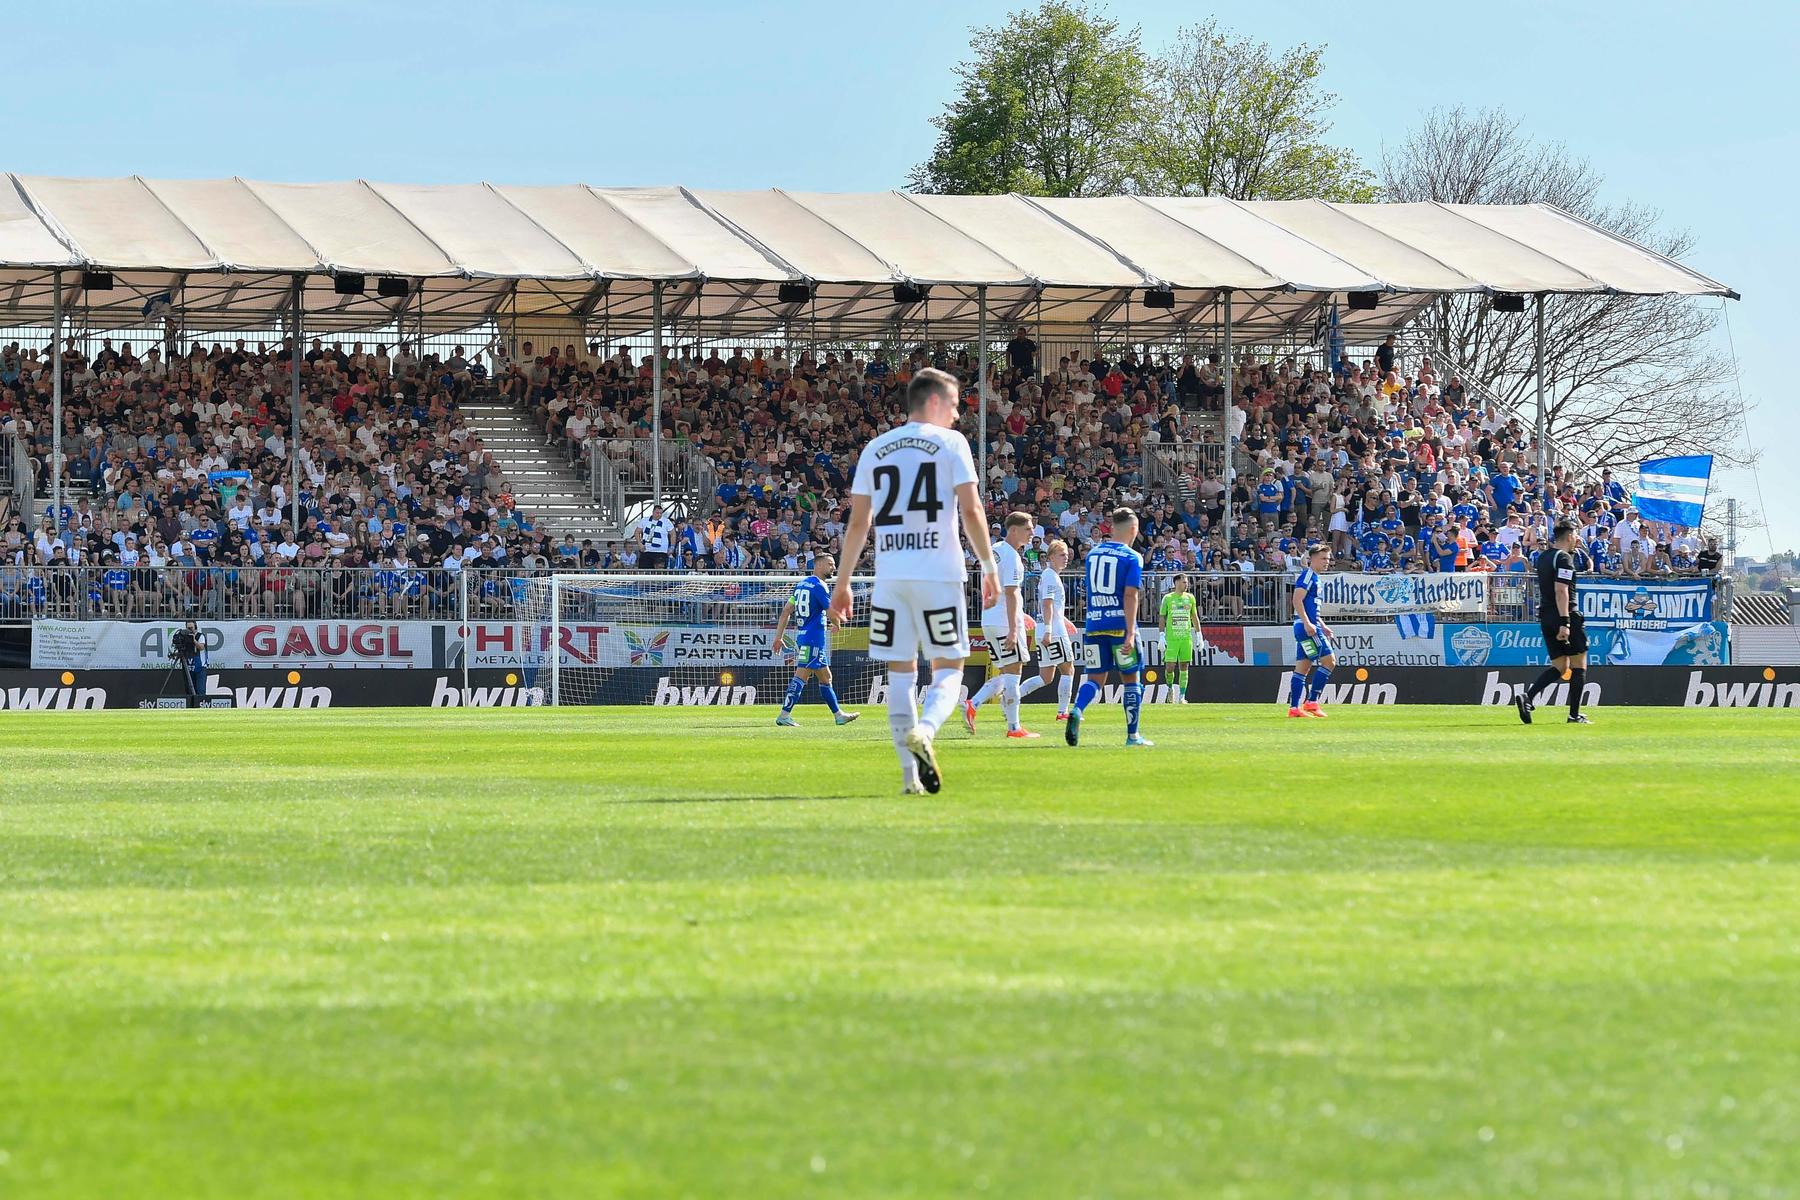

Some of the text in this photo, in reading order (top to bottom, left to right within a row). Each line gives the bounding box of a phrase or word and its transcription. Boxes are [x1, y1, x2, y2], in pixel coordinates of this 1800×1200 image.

[873, 462, 944, 526] 24
[1089, 555, 1118, 594] 10
[1412, 575, 1484, 604] Hartberg
[680, 633, 767, 645] FARBEN
[1496, 629, 1542, 648] Blau
[1615, 619, 1668, 630] HARTBERG
[242, 624, 413, 658] GAUGL
[674, 647, 773, 660] PARTNER
[0, 672, 106, 709] win
[654, 671, 757, 706] bwin
[1683, 667, 1800, 707] bwin
[139, 699, 184, 709] sky sport
[200, 699, 211, 709] sky
